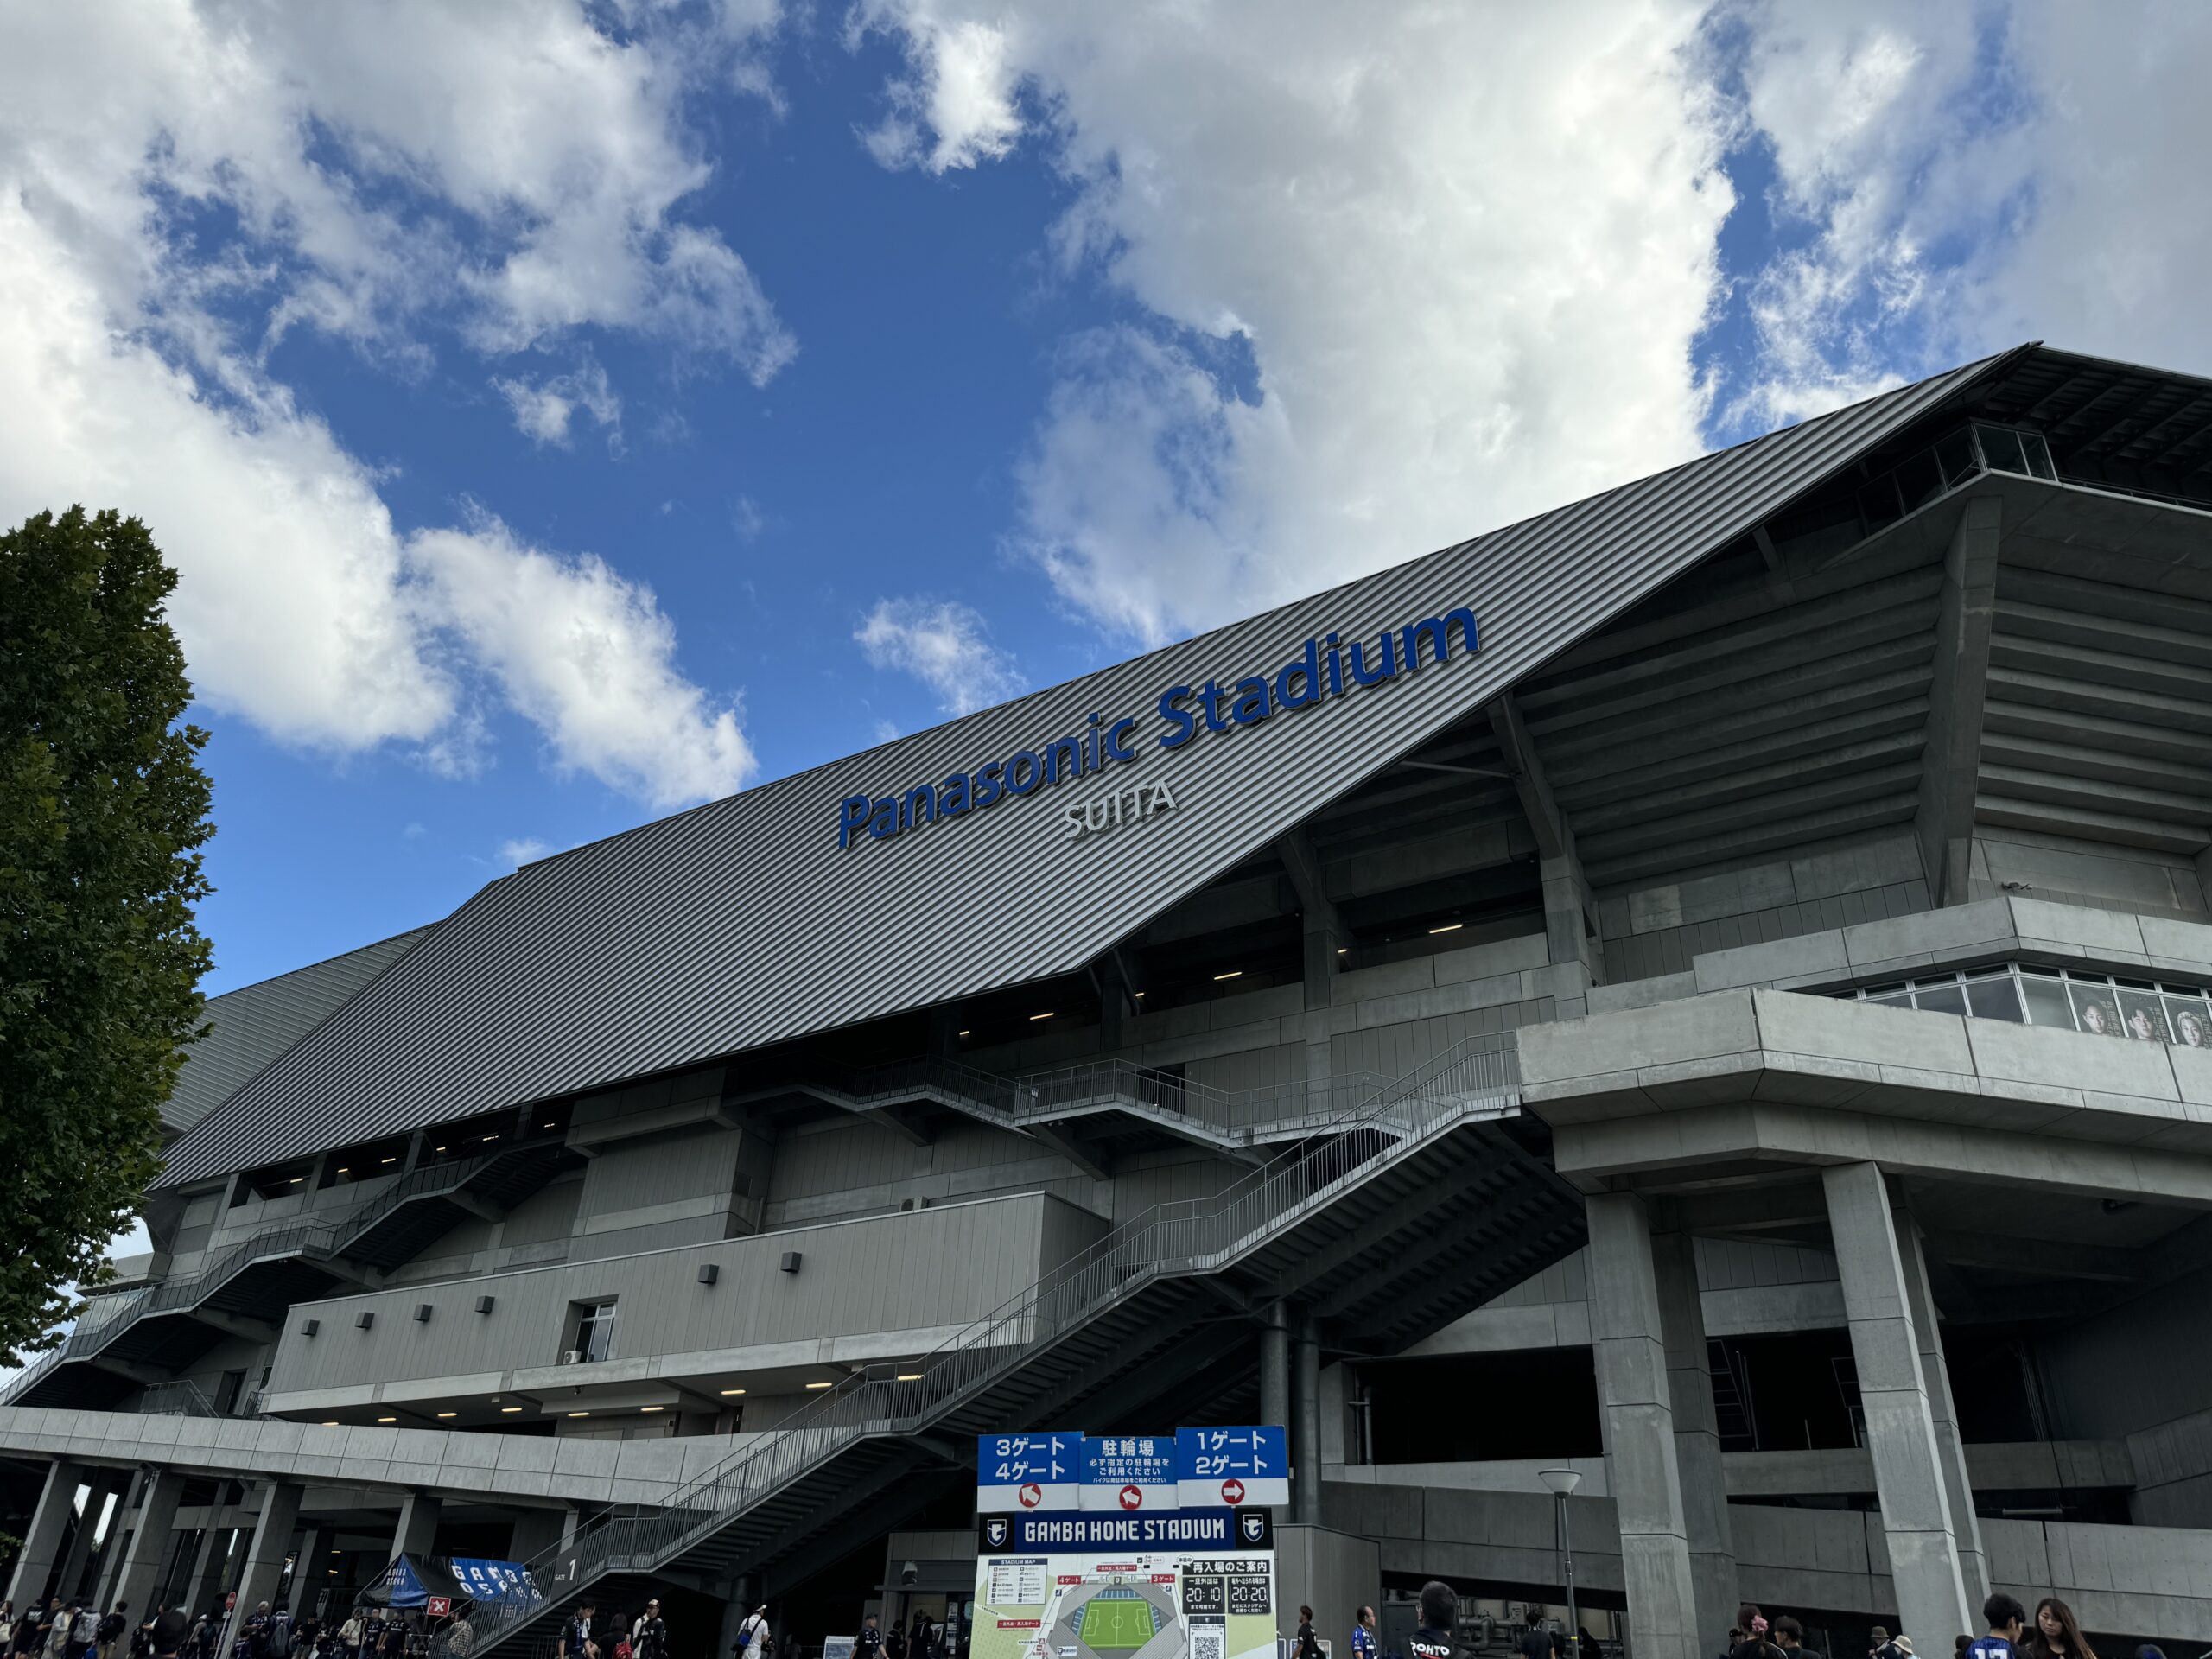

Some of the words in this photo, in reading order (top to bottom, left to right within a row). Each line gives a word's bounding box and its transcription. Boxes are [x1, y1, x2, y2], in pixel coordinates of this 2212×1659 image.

[838, 712, 1136, 849] Panasonic
[1158, 605, 1481, 748] Stadium
[1064, 779, 1179, 841] SUITA
[996, 1436, 1065, 1457] 3ゲート
[1102, 1440, 1154, 1457] 駐輪場
[1197, 1430, 1266, 1451] 1ゲート
[995, 1460, 1065, 1481] 4ゲート
[1090, 1458, 1170, 1467] 必ず指定の駐輪場を
[1099, 1467, 1160, 1476] ご利用ください
[1196, 1454, 1268, 1475] 2ゲート
[1024, 1521, 1086, 1542] GAMBA
[1090, 1520, 1139, 1541] HOME
[1144, 1518, 1224, 1540] STADIUM
[1193, 1560, 1267, 1573] 再入場のご案内
[1231, 1586, 1267, 1601] 20:20
